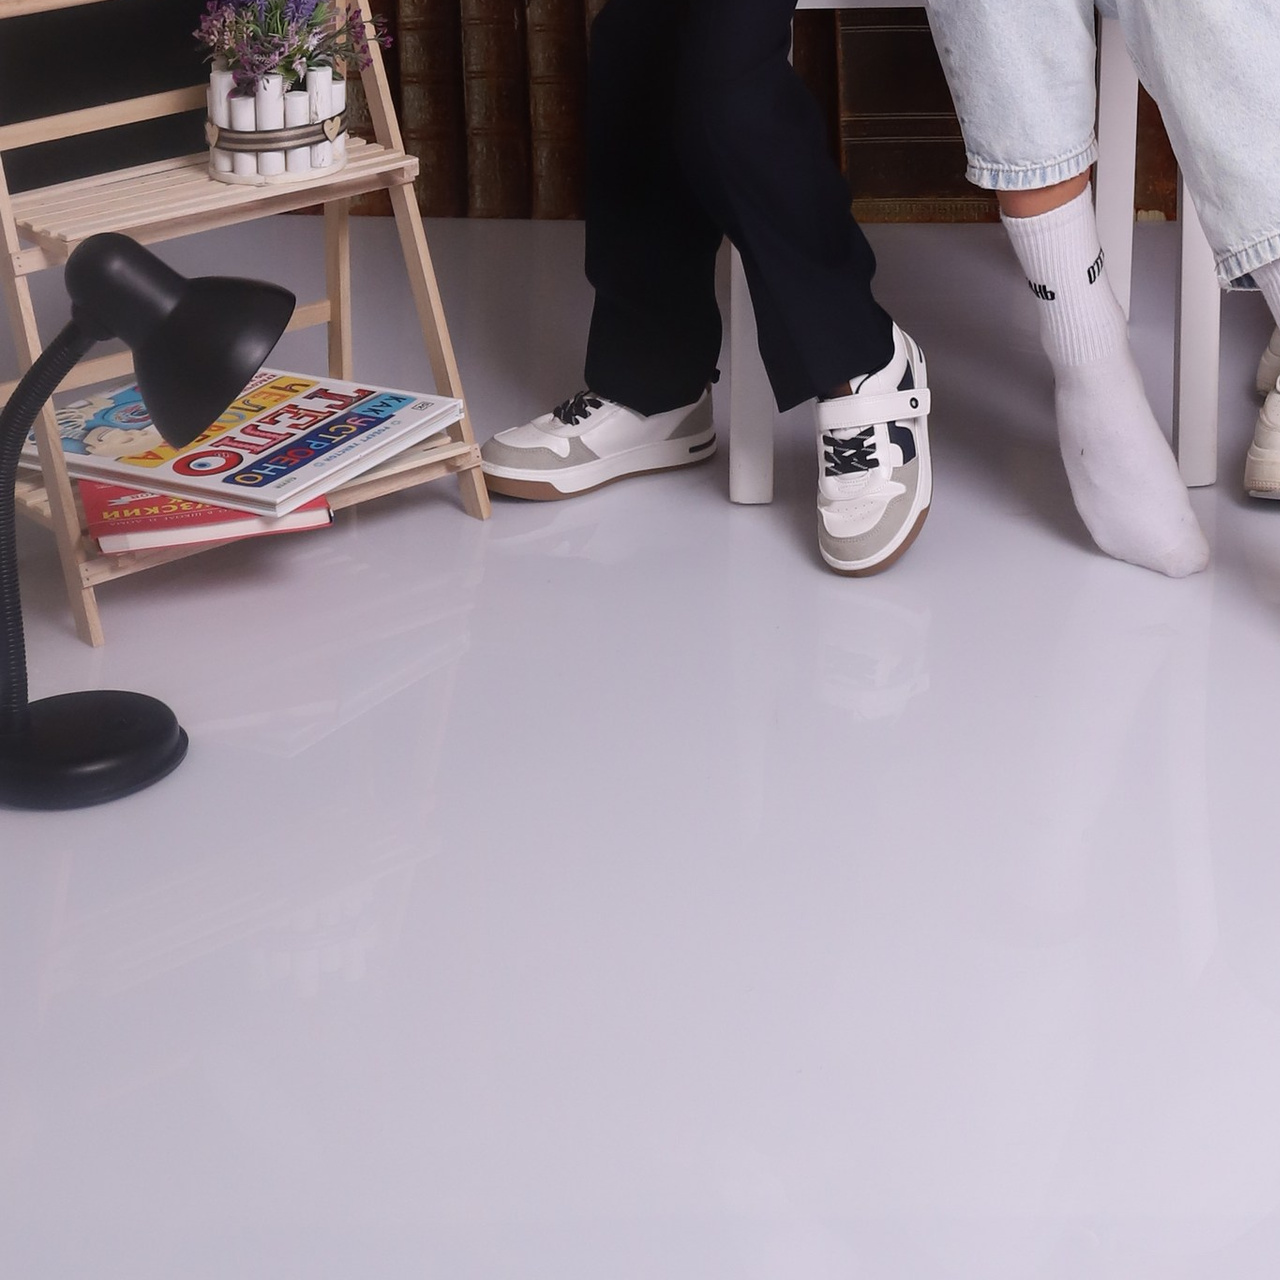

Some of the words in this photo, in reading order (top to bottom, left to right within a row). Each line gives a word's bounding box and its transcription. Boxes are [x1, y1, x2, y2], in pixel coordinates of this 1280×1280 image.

[172, 387, 378, 477] ТЕЛО
[361, 394, 409, 417] КАК
[233, 416, 377, 485] УСТРОЕНО
